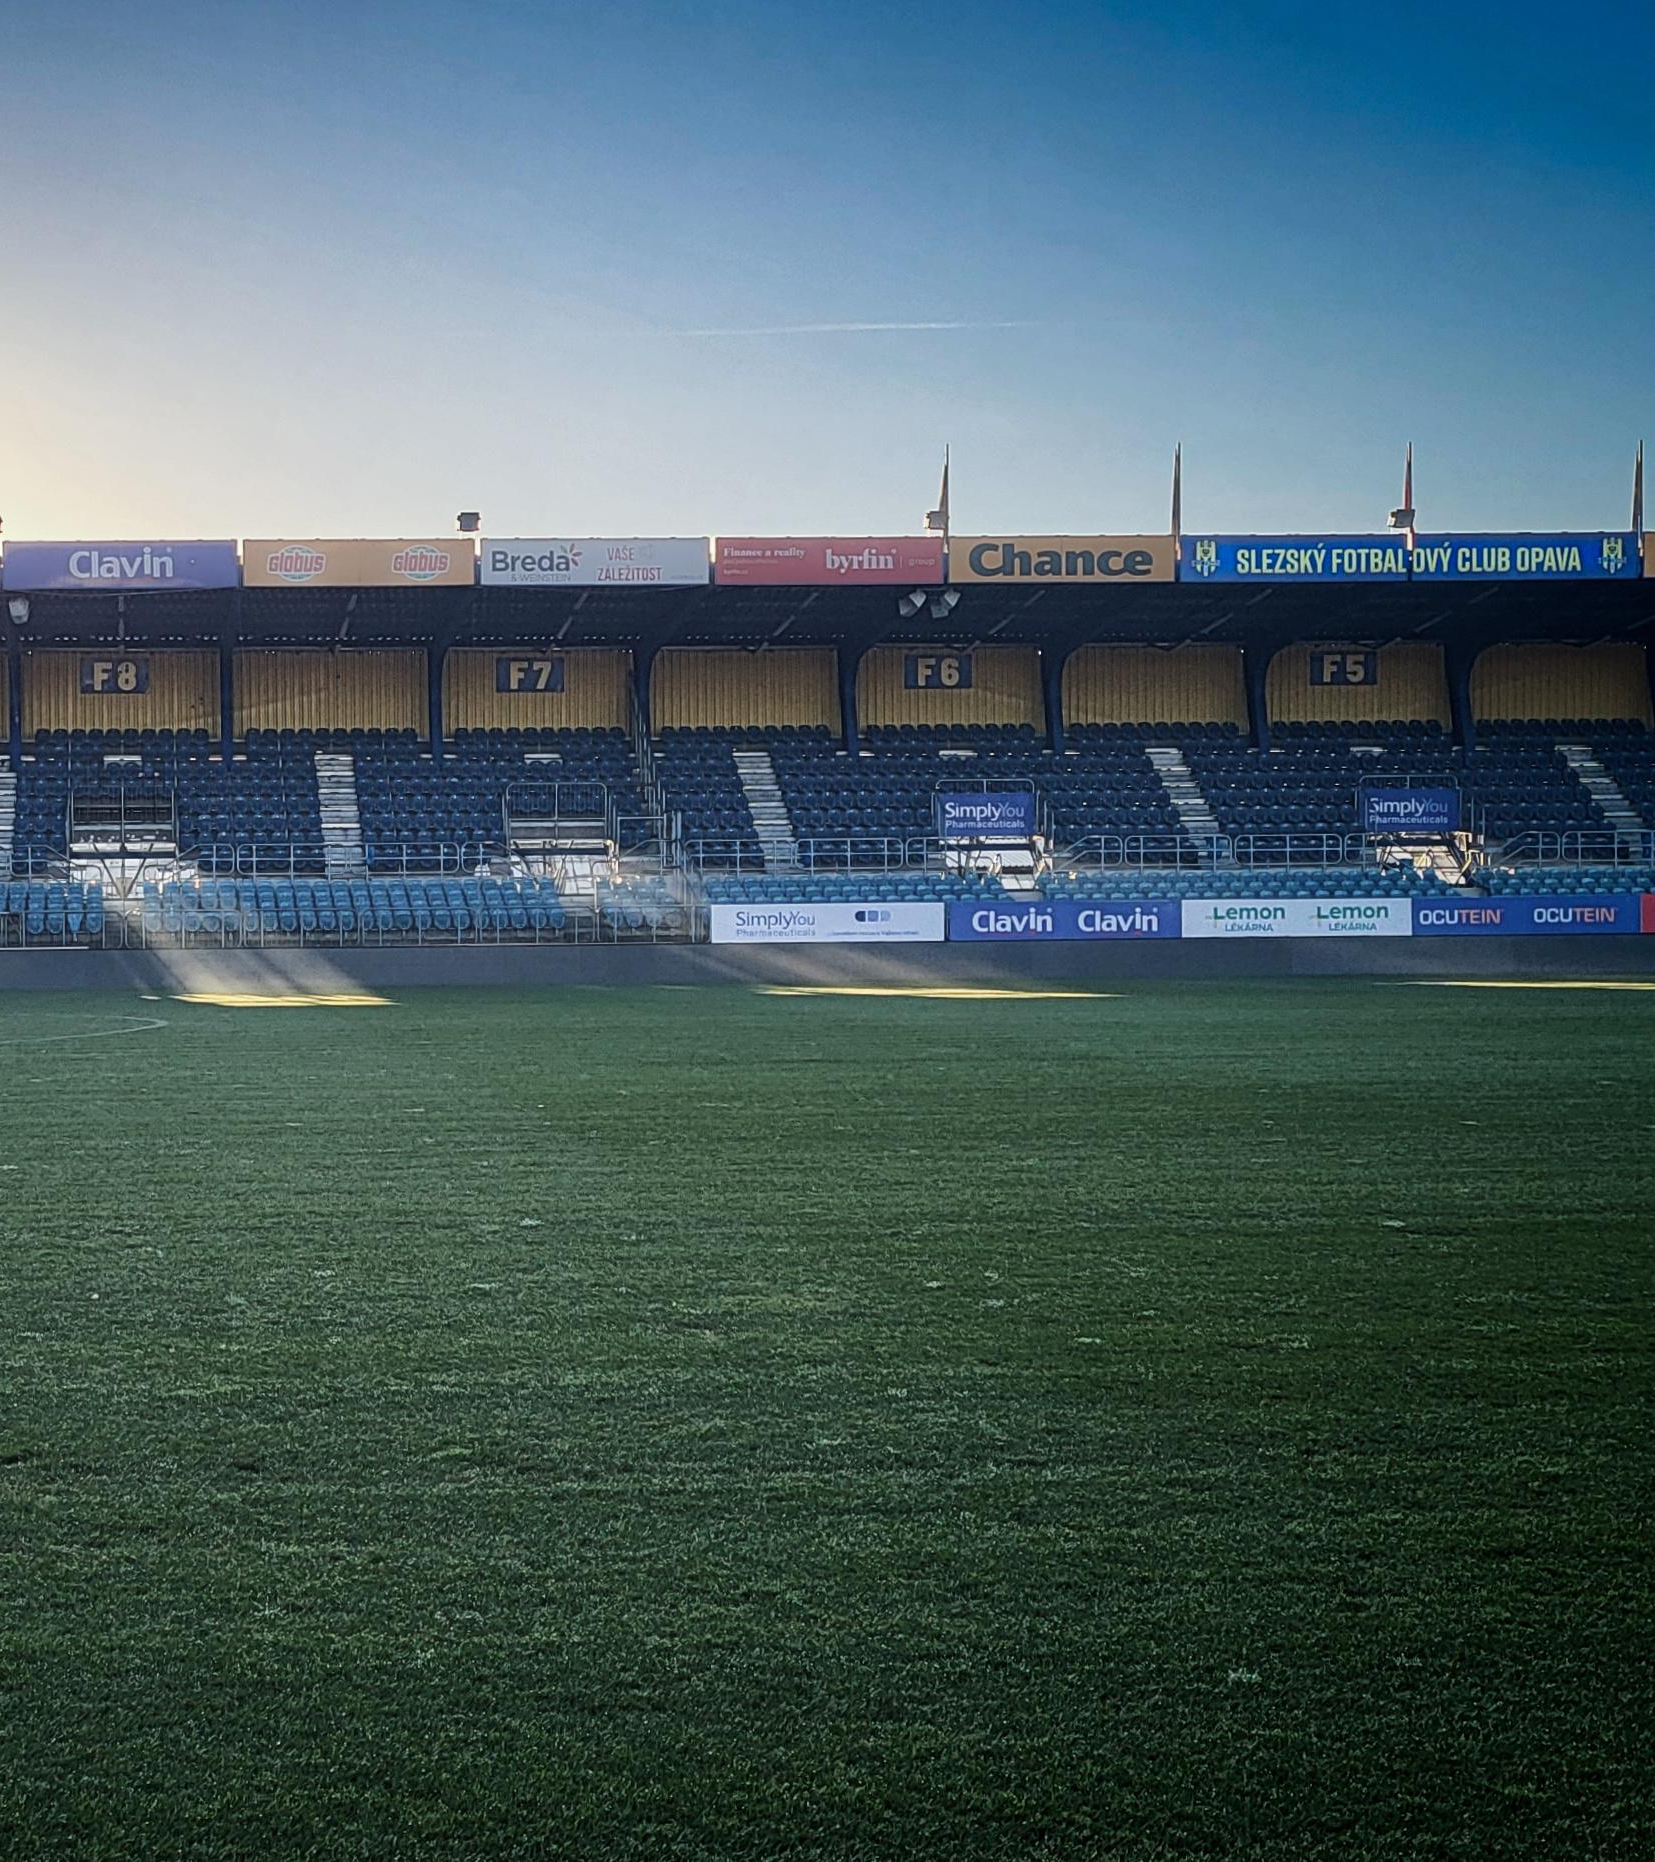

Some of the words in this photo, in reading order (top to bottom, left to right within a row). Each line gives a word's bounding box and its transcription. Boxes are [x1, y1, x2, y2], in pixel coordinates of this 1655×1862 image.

[491, 550, 570, 572] Breda
[607, 545, 635, 561] VAŠE
[724, 547, 763, 557] Finance
[774, 547, 806, 559] reality
[825, 549, 894, 573] byrfin
[968, 543, 1154, 577] Chance
[1237, 543, 1325, 574] SLEZSKÝ
[1457, 548, 1511, 573] CLUB
[1516, 547, 1583, 573] OPAVA
[69, 547, 174, 578] Clavin
[908, 558, 935, 568] group
[597, 565, 662, 581] ZÁLEŽITOST
[945, 802, 1025, 821] SimplyYou
[1369, 815, 1448, 824] Pharmaceuticals
[945, 820, 1025, 829] Pharmaceuticals
[736, 911, 815, 929] SimplyYou
[972, 907, 1053, 932] Clavin
[1078, 907, 1158, 932] Clavin
[1213, 906, 1285, 920] Lemon
[1317, 905, 1389, 919] Lemon
[1419, 909, 1501, 925] OCUTEIN
[1533, 908, 1615, 923] OCUTEIN
[736, 928, 815, 937] Pharmaceuticals
